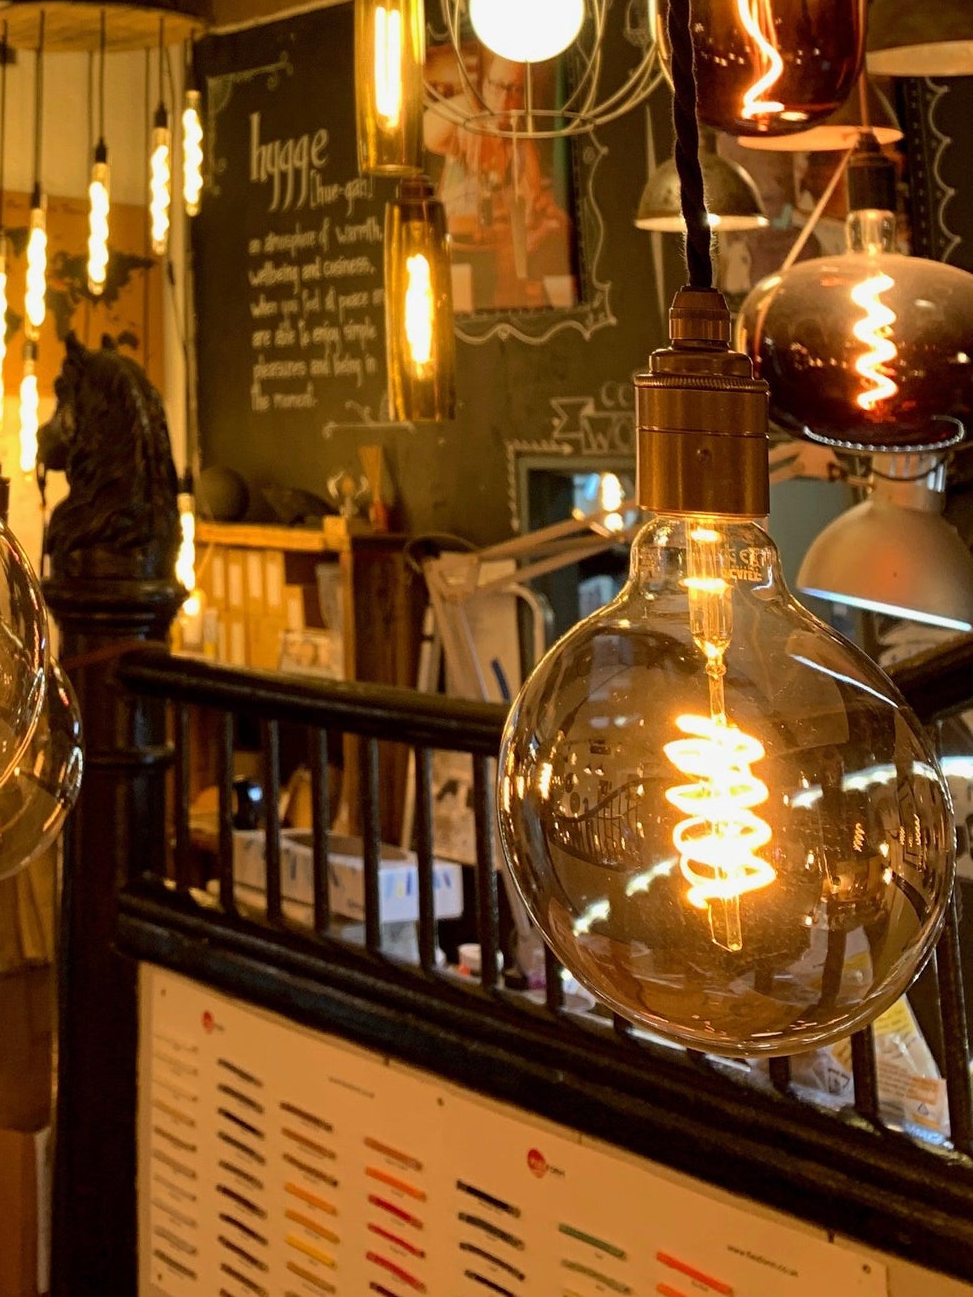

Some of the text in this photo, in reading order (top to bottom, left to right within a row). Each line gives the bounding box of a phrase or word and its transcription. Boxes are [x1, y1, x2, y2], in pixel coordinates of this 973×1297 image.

[250, 111, 329, 212] hygge
[319, 217, 331, 252] of
[248, 260, 300, 295] wellbeing
[302, 256, 322, 281] and
[250, 294, 278, 318] when
[280, 300, 299, 323] you
[302, 288, 321, 319] feel
[338, 291, 368, 324] peace
[251, 330, 272, 349] are
[275, 320, 296, 347] able
[312, 320, 342, 359] enjoy
[343, 316, 377, 351] simple
[252, 352, 376, 389] pleasures and being in
[251, 383, 270, 412] the
